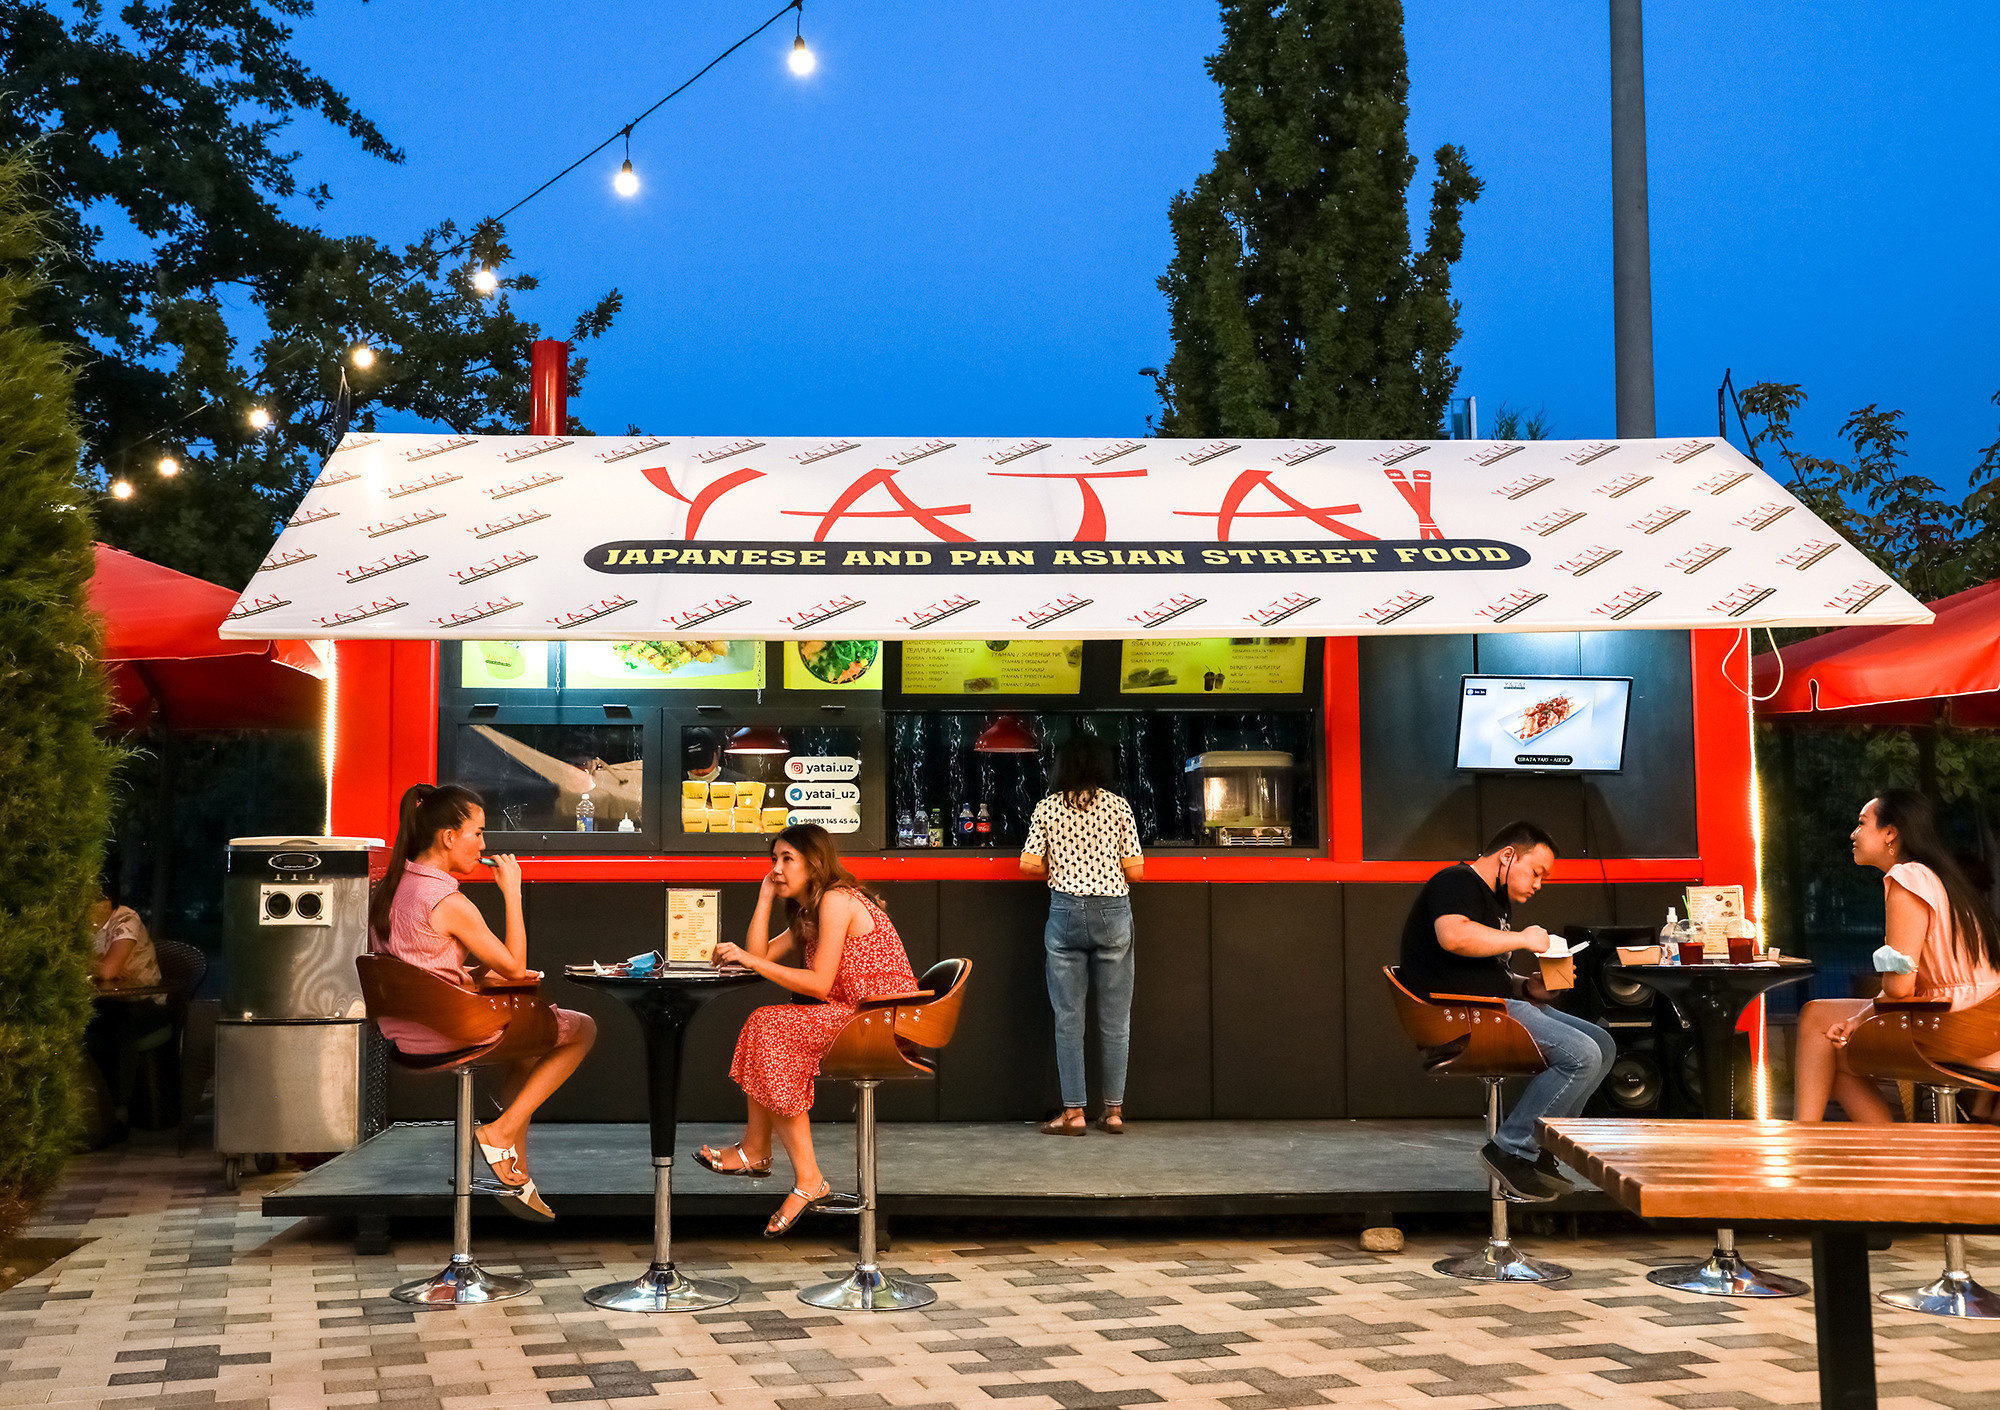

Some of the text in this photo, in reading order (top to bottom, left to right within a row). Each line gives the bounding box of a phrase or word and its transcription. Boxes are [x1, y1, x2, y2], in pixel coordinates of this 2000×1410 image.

[604, 547, 1511, 566] JAPANESE AND PAN ASIAN STREET FOOD
[806, 762, 854, 775] yatai.uz
[805, 788, 856, 801] yatai_uz
